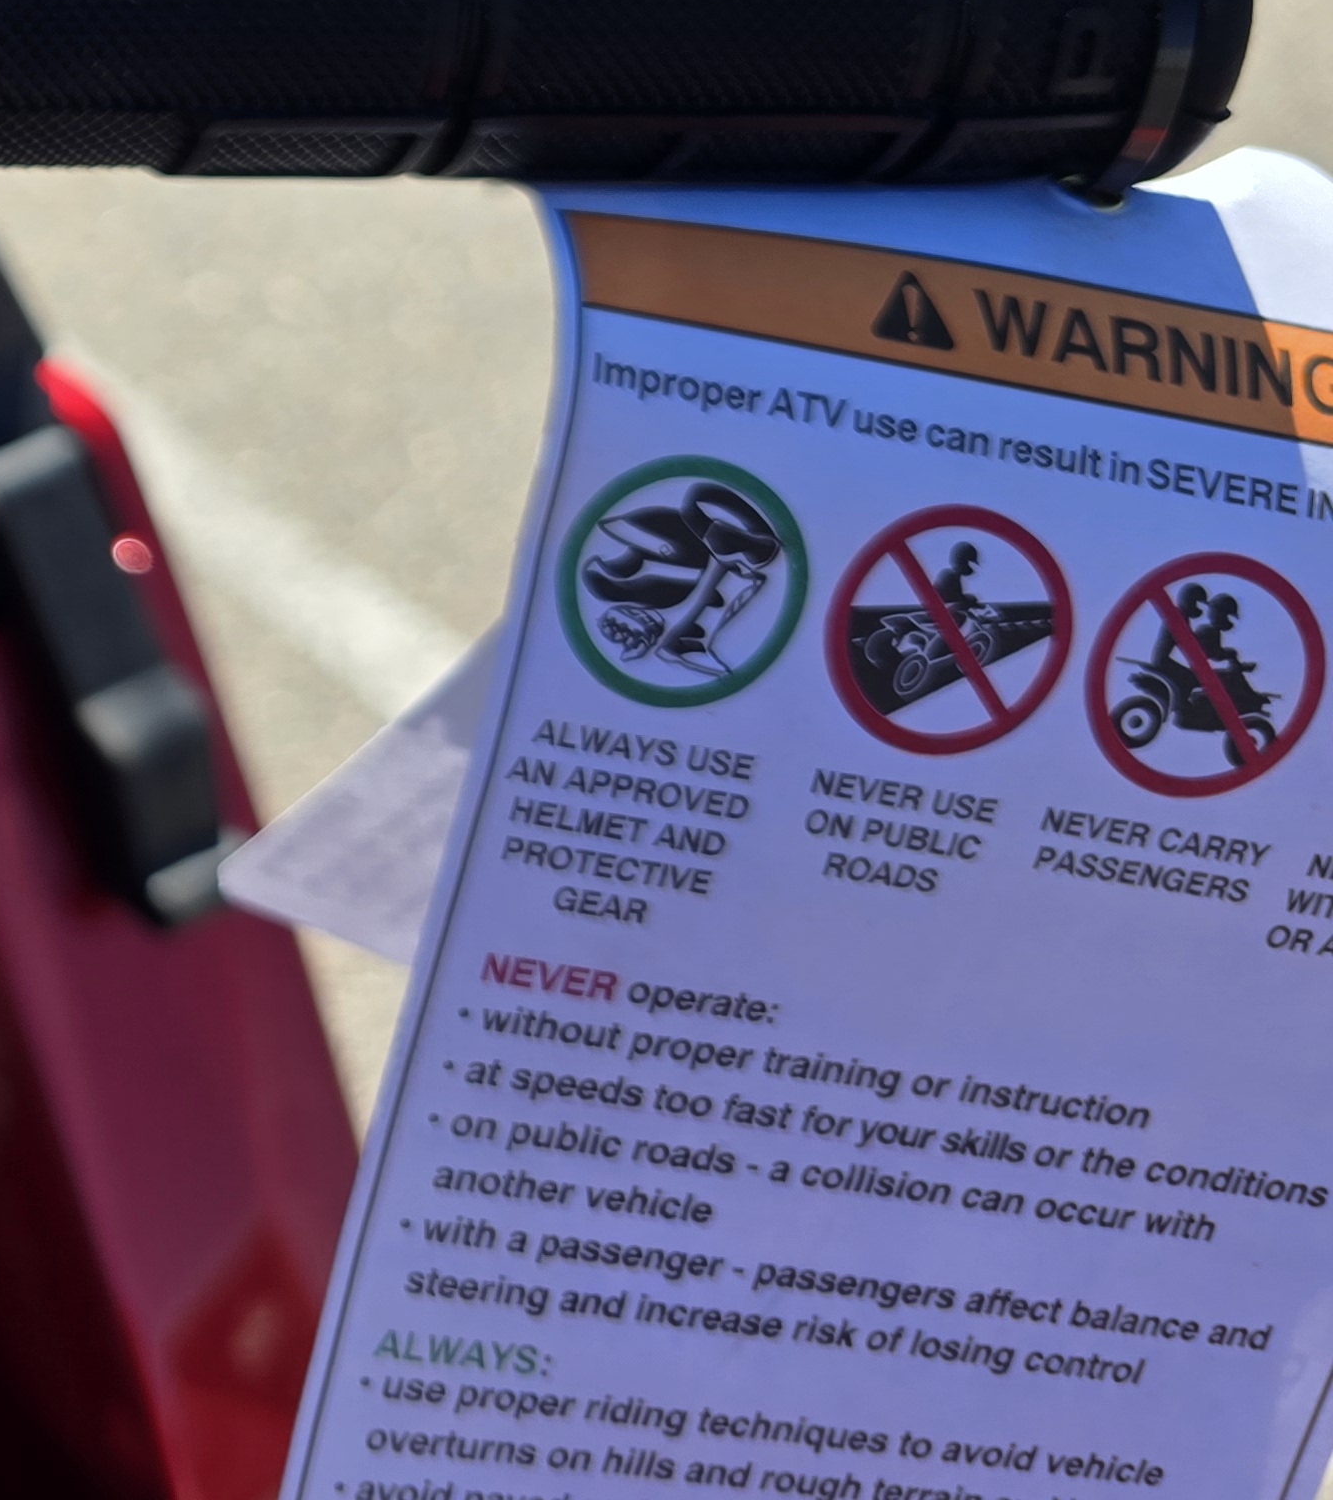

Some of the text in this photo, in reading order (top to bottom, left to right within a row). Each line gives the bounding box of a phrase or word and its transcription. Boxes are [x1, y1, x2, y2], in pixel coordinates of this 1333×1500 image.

[592, 351, 761, 412] Improper
[768, 387, 848, 428] ATV
[853, 409, 918, 442] use
[927, 420, 989, 456] can
[999, 437, 1102, 478] result
[1110, 450, 1139, 486] in
[1147, 458, 1298, 515] SEVERE
[532, 718, 756, 781] ALWAYS USE
[504, 756, 750, 820] AN APPROVED
[810, 768, 999, 825] NEVER USE
[508, 797, 727, 857] HELMET AND
[804, 807, 982, 861] ON PUBLIC
[1040, 807, 1271, 867] NEVER CARRY
[500, 835, 713, 895] PROTECTIVE
[822, 851, 939, 893] ROADS
[1033, 846, 1250, 903] PASSENGERS
[552, 886, 648, 924] GEAR
[1266, 924, 1315, 953] OR
[481, 953, 781, 1024] NEVER operate:
[483, 1006, 1150, 1129] without proper training or instruction
[464, 1059, 1329, 1209] at speeds too fast for your skills or the conditions
[433, 1165, 714, 1224] another vehicle
[449, 1113, 497, 1140] on
[506, 1119, 622, 1159] public
[632, 1139, 736, 1174] roads
[768, 1160, 790, 1183] a
[801, 1163, 951, 1206] collision
[962, 1186, 1024, 1214] can
[1034, 1198, 1136, 1230] occur
[1144, 1210, 1216, 1242] with
[423, 1216, 496, 1252] with
[507, 1230, 528, 1253] a
[535, 1233, 724, 1281] passenger
[751, 1262, 955, 1310] passengers
[965, 1289, 1061, 1323] affect
[1070, 1299, 1200, 1342] balance
[1208, 1321, 1273, 1352] and
[374, 1328, 556, 1376] ALWAYS:
[404, 1268, 1146, 1384] steering and increase risk of losing control
[382, 1373, 1163, 1487] use proper riding techniques to avoid vehicle
[366, 1427, 536, 1466] overturns
[546, 1446, 592, 1472] on
[601, 1446, 675, 1480] hills
[685, 1461, 753, 1489] and
[759, 1470, 862, 1500] rough
